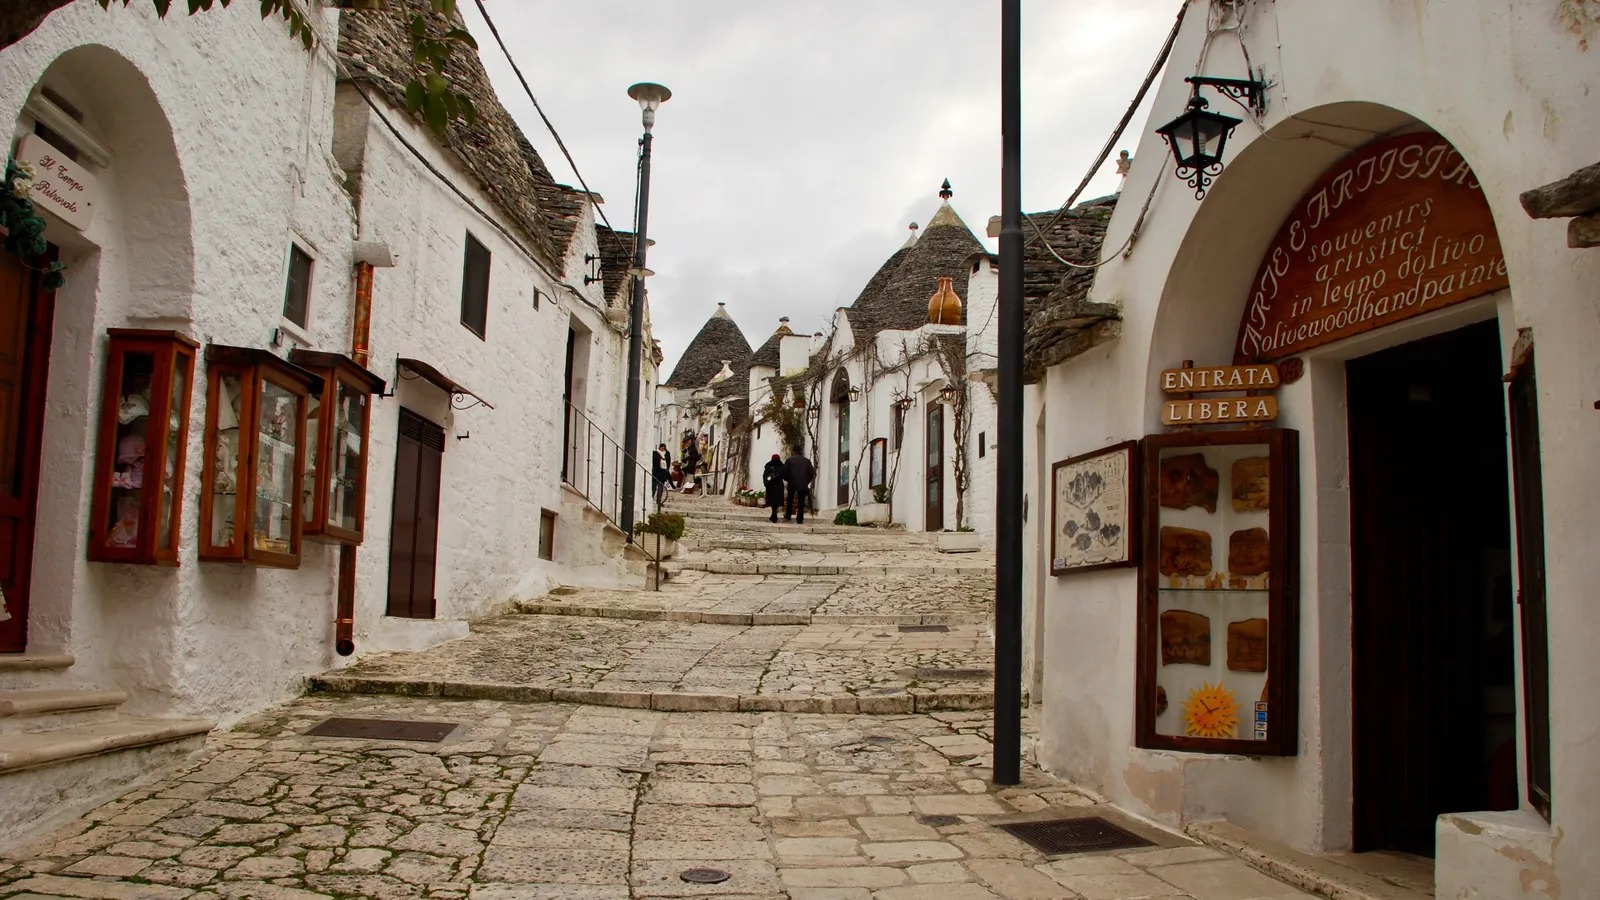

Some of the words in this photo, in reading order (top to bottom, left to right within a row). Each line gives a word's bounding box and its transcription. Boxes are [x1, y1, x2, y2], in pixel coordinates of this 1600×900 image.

[39, 155, 56, 170] Il
[58, 165, 84, 192] Tempo
[35, 180, 77, 213] Ritrovato
[1307, 197, 1433, 263] souvenirs
[1242, 246, 1290, 357] ARTE
[1290, 219, 1307, 252] E
[1306, 144, 1481, 229] ARTIGIA
[1315, 219, 1428, 282] artistici
[1290, 294, 1313, 318] in
[1321, 277, 1386, 309] legno
[1164, 367, 1275, 390] ENTRATA
[1169, 399, 1270, 421] LIBERA
